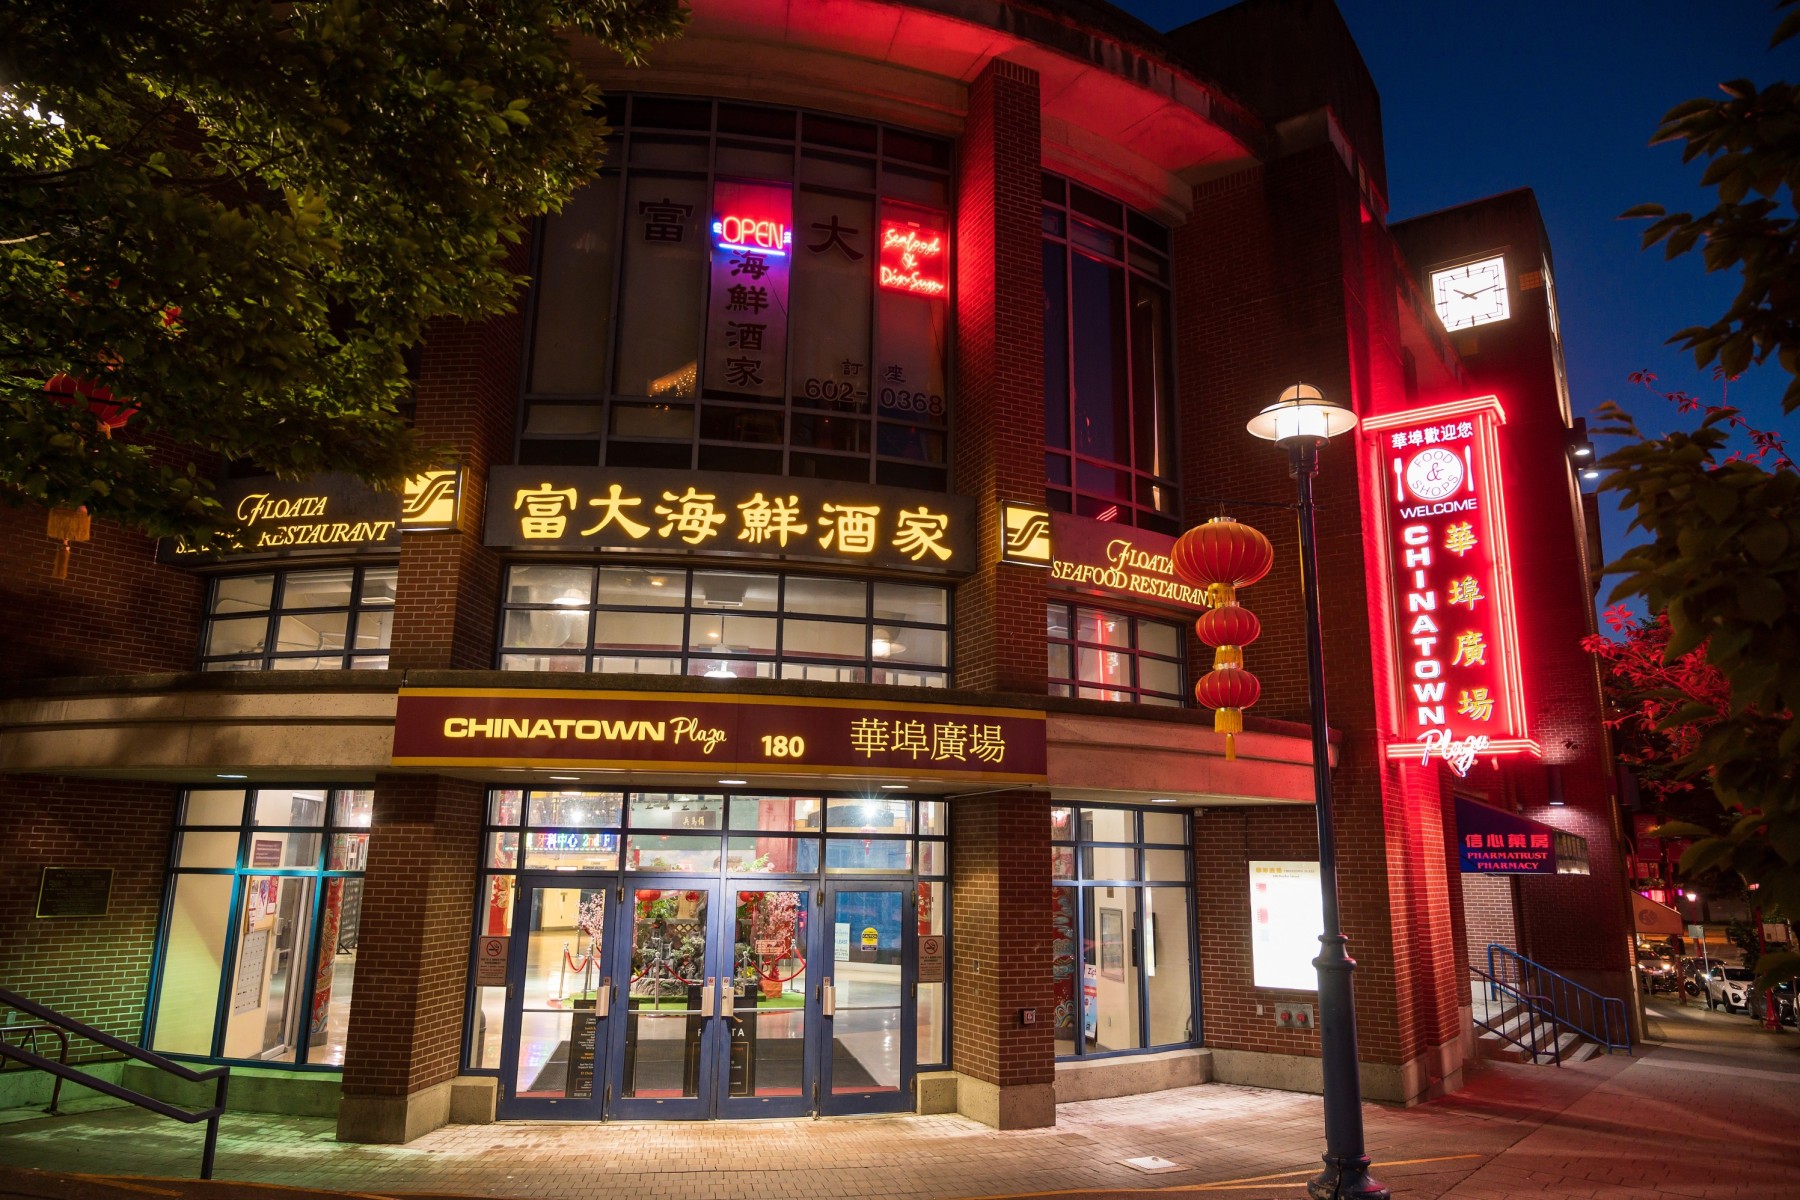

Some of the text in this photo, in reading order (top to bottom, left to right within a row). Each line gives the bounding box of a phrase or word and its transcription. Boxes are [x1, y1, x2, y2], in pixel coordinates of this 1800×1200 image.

[639, 198, 865, 261] 富 大
[722, 215, 785, 250] OPEN
[884, 229, 941, 253] Seafood
[725, 248, 770, 386] 海鮮酒家
[1391, 421, 1474, 450] 華埠歡迎您
[1413, 450, 1454, 468] FOOD
[1426, 462, 1445, 482] &
[1411, 474, 1459, 496] SHOPS
[513, 482, 953, 562] 富大海鮮酒家
[1399, 498, 1478, 519] WELCOME
[257, 520, 396, 547] RESTAURANT
[1051, 560, 1128, 589] SEAFOOD
[1404, 524, 1446, 727] CHINATOWN
[1444, 521, 1495, 722] 華埠廣場
[443, 716, 1006, 764] CHINATOWN Plaza 180 華埠廣場
[1416, 728, 1491, 775] Plaza
[582, 833, 600, 848] 2nd
